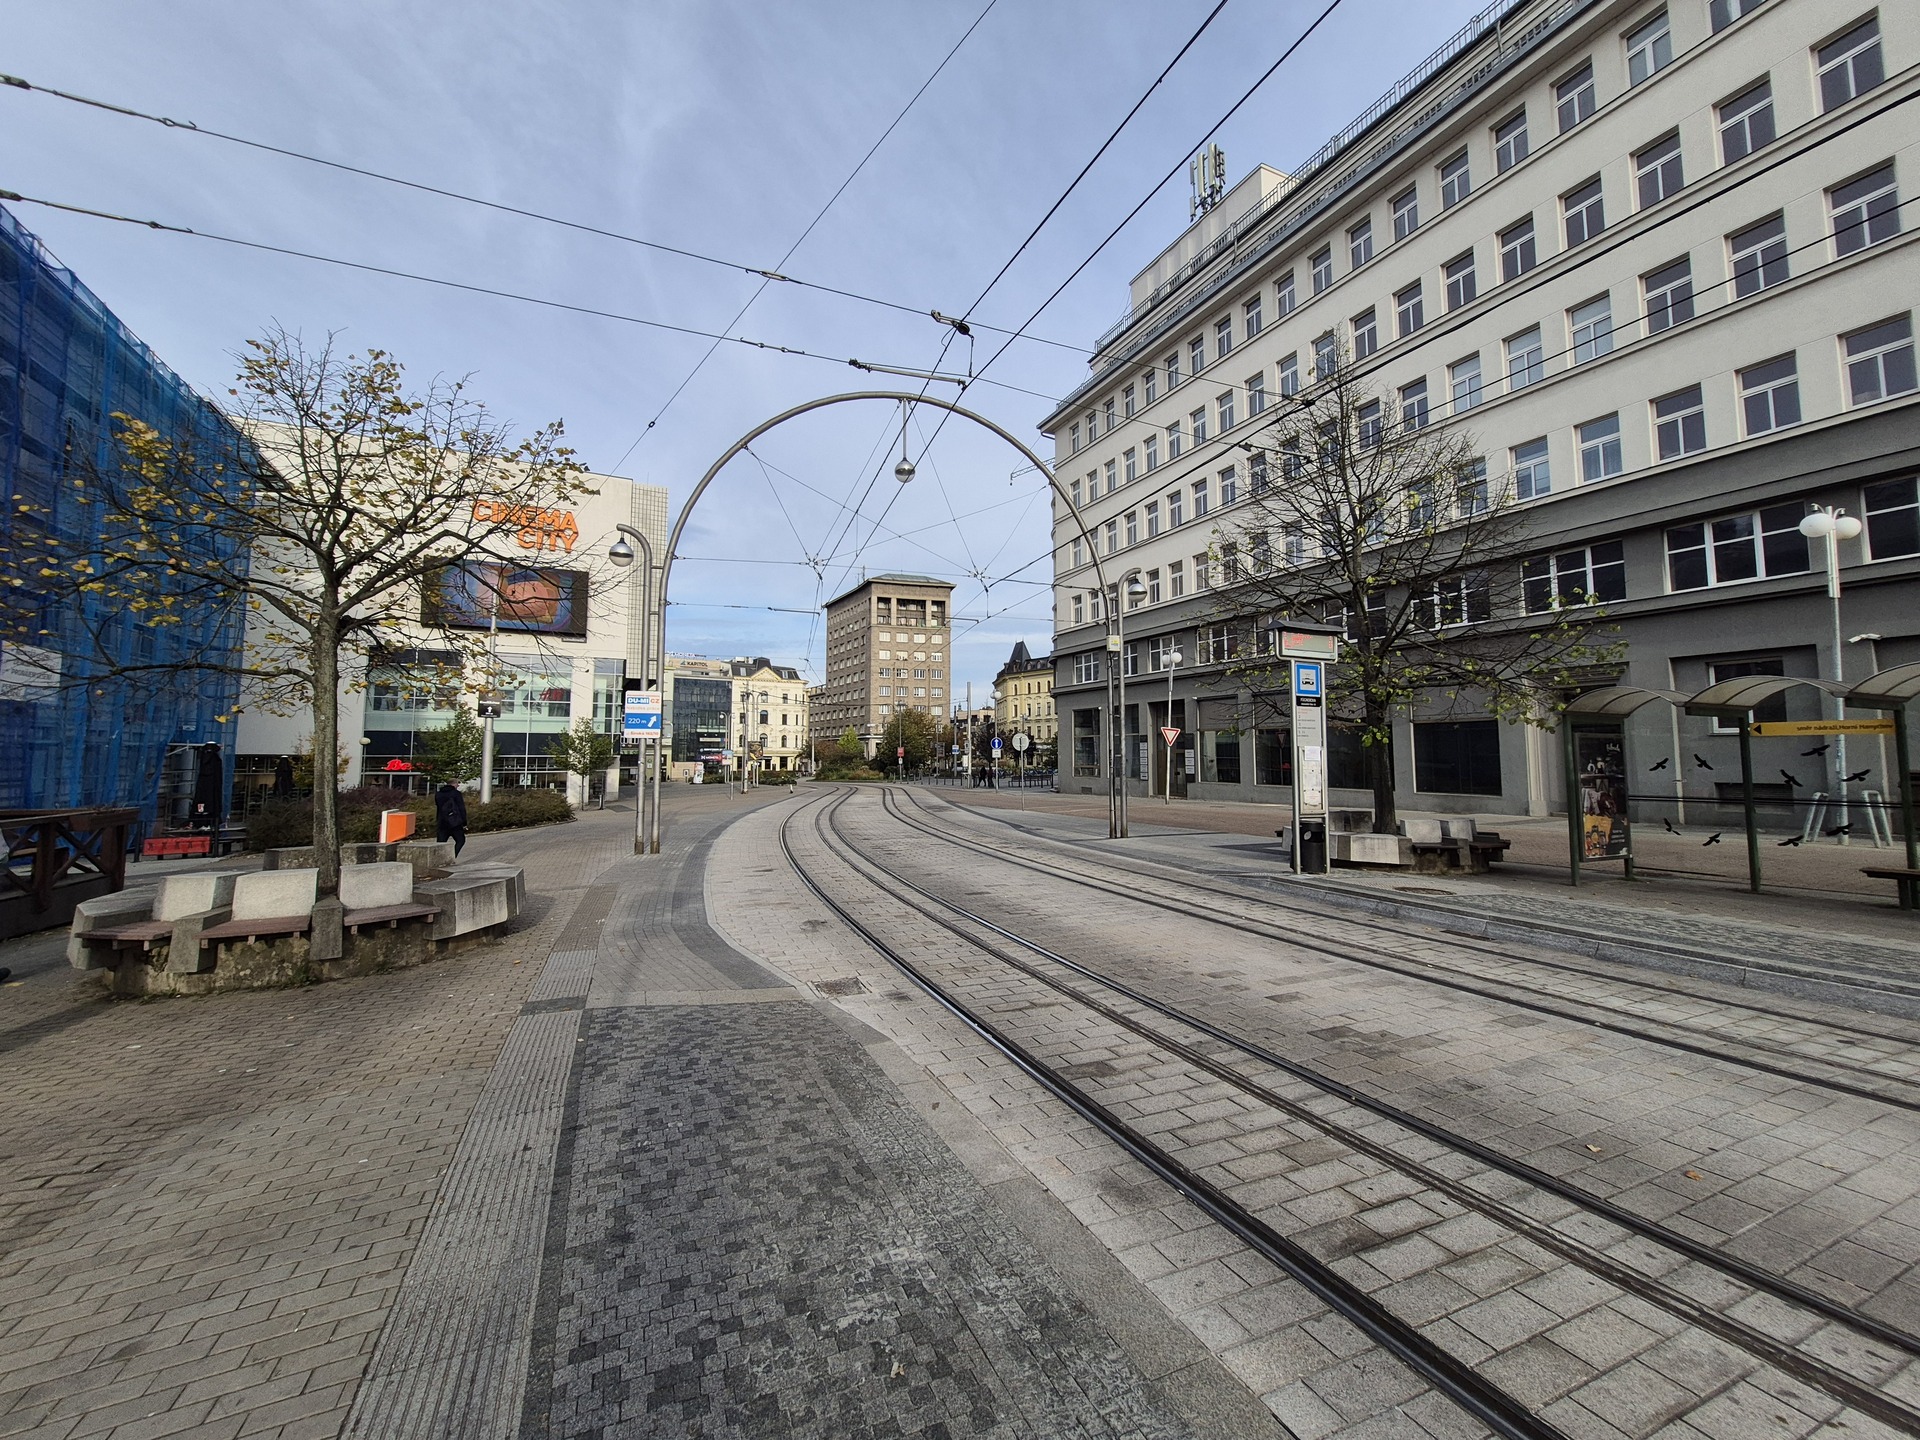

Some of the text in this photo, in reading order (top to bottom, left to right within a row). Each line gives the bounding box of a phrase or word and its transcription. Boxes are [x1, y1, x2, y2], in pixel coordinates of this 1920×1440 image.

[473, 500, 579, 533] CINEMA
[517, 527, 579, 553] CITY
[687, 660, 708, 668] KAPITOL
